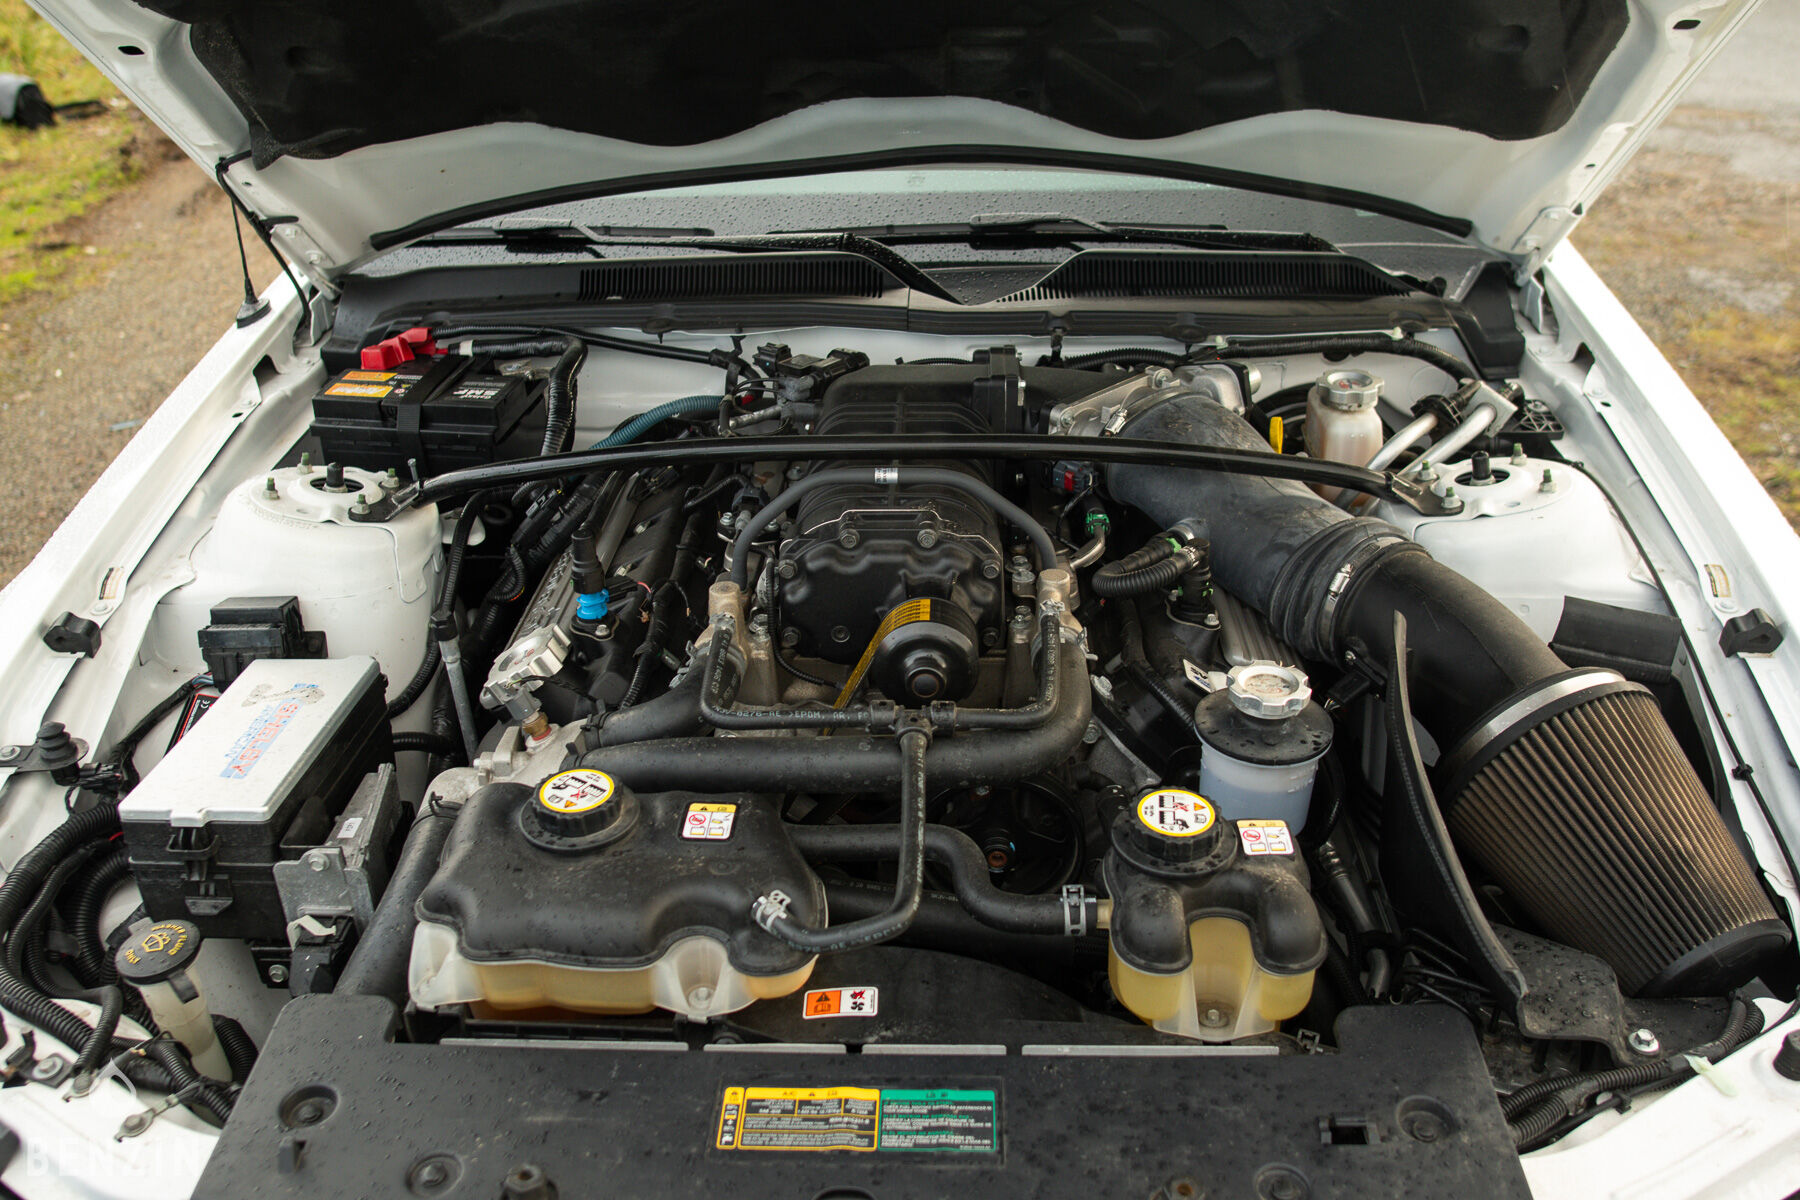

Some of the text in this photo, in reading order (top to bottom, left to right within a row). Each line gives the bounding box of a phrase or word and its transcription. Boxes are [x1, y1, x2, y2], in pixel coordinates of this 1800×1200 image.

[231, 702, 299, 775] SHELBY
[151, 923, 188, 956] WASHER FLUID
[125, 949, 141, 964] ONLY
